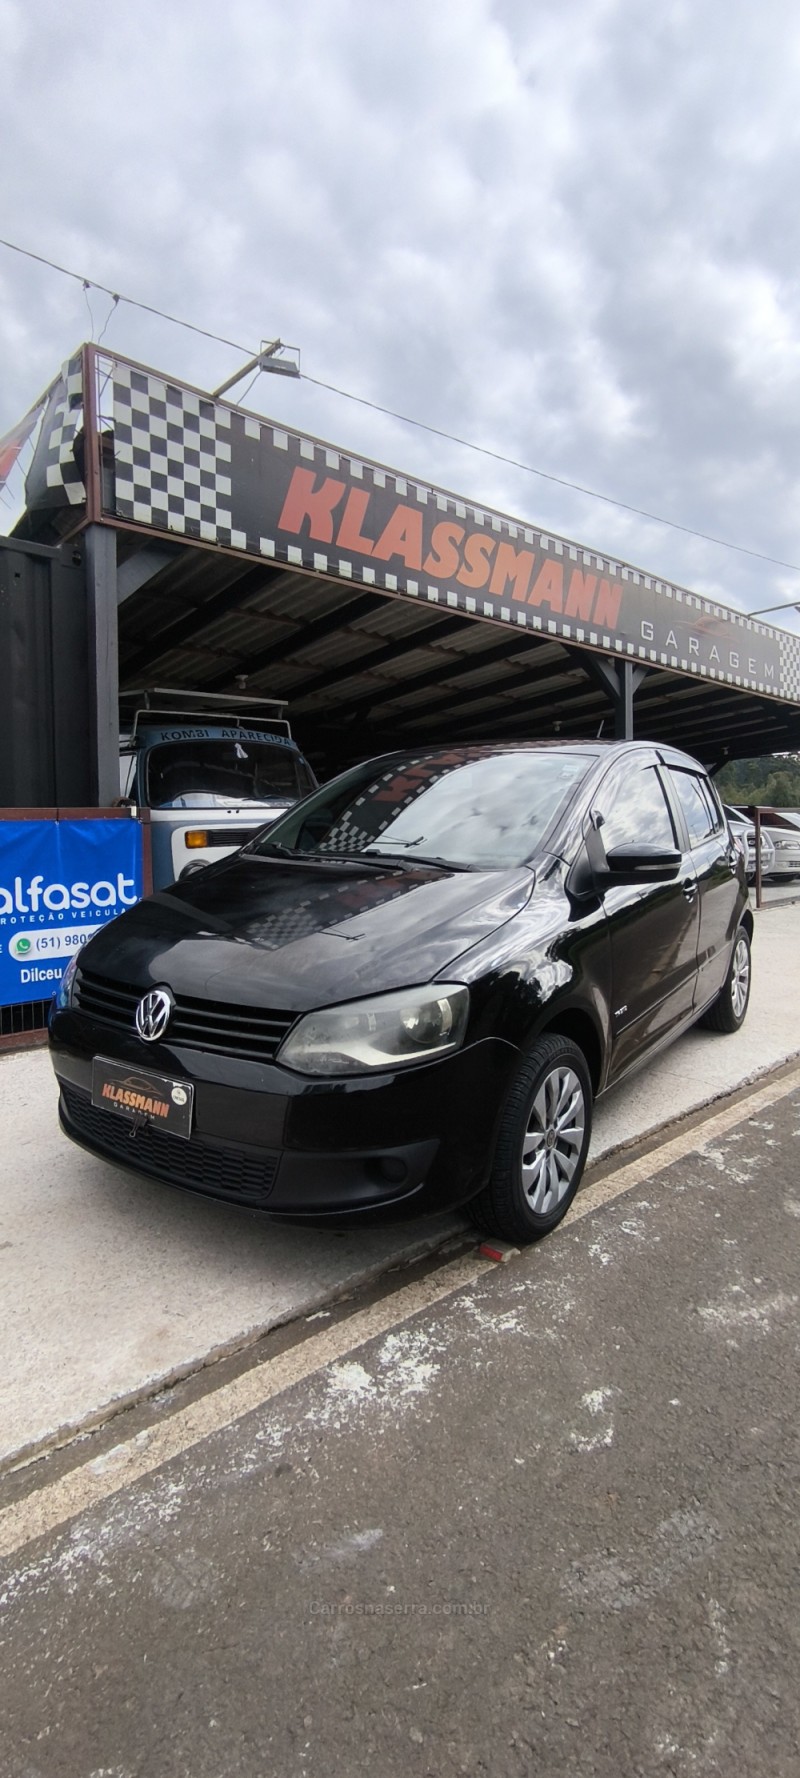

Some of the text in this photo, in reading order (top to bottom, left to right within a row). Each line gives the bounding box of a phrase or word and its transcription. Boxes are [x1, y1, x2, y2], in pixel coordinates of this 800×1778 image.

[278, 466, 623, 630] KLASSMANN
[640, 620, 774, 680] GARAGEM
[160, 729, 292, 746] KOMBI APARECIDA
[36, 936, 61, 952] (51)
[20, 967, 62, 984] Dilceu
[102, 1083, 170, 1118] KLASSMANN
